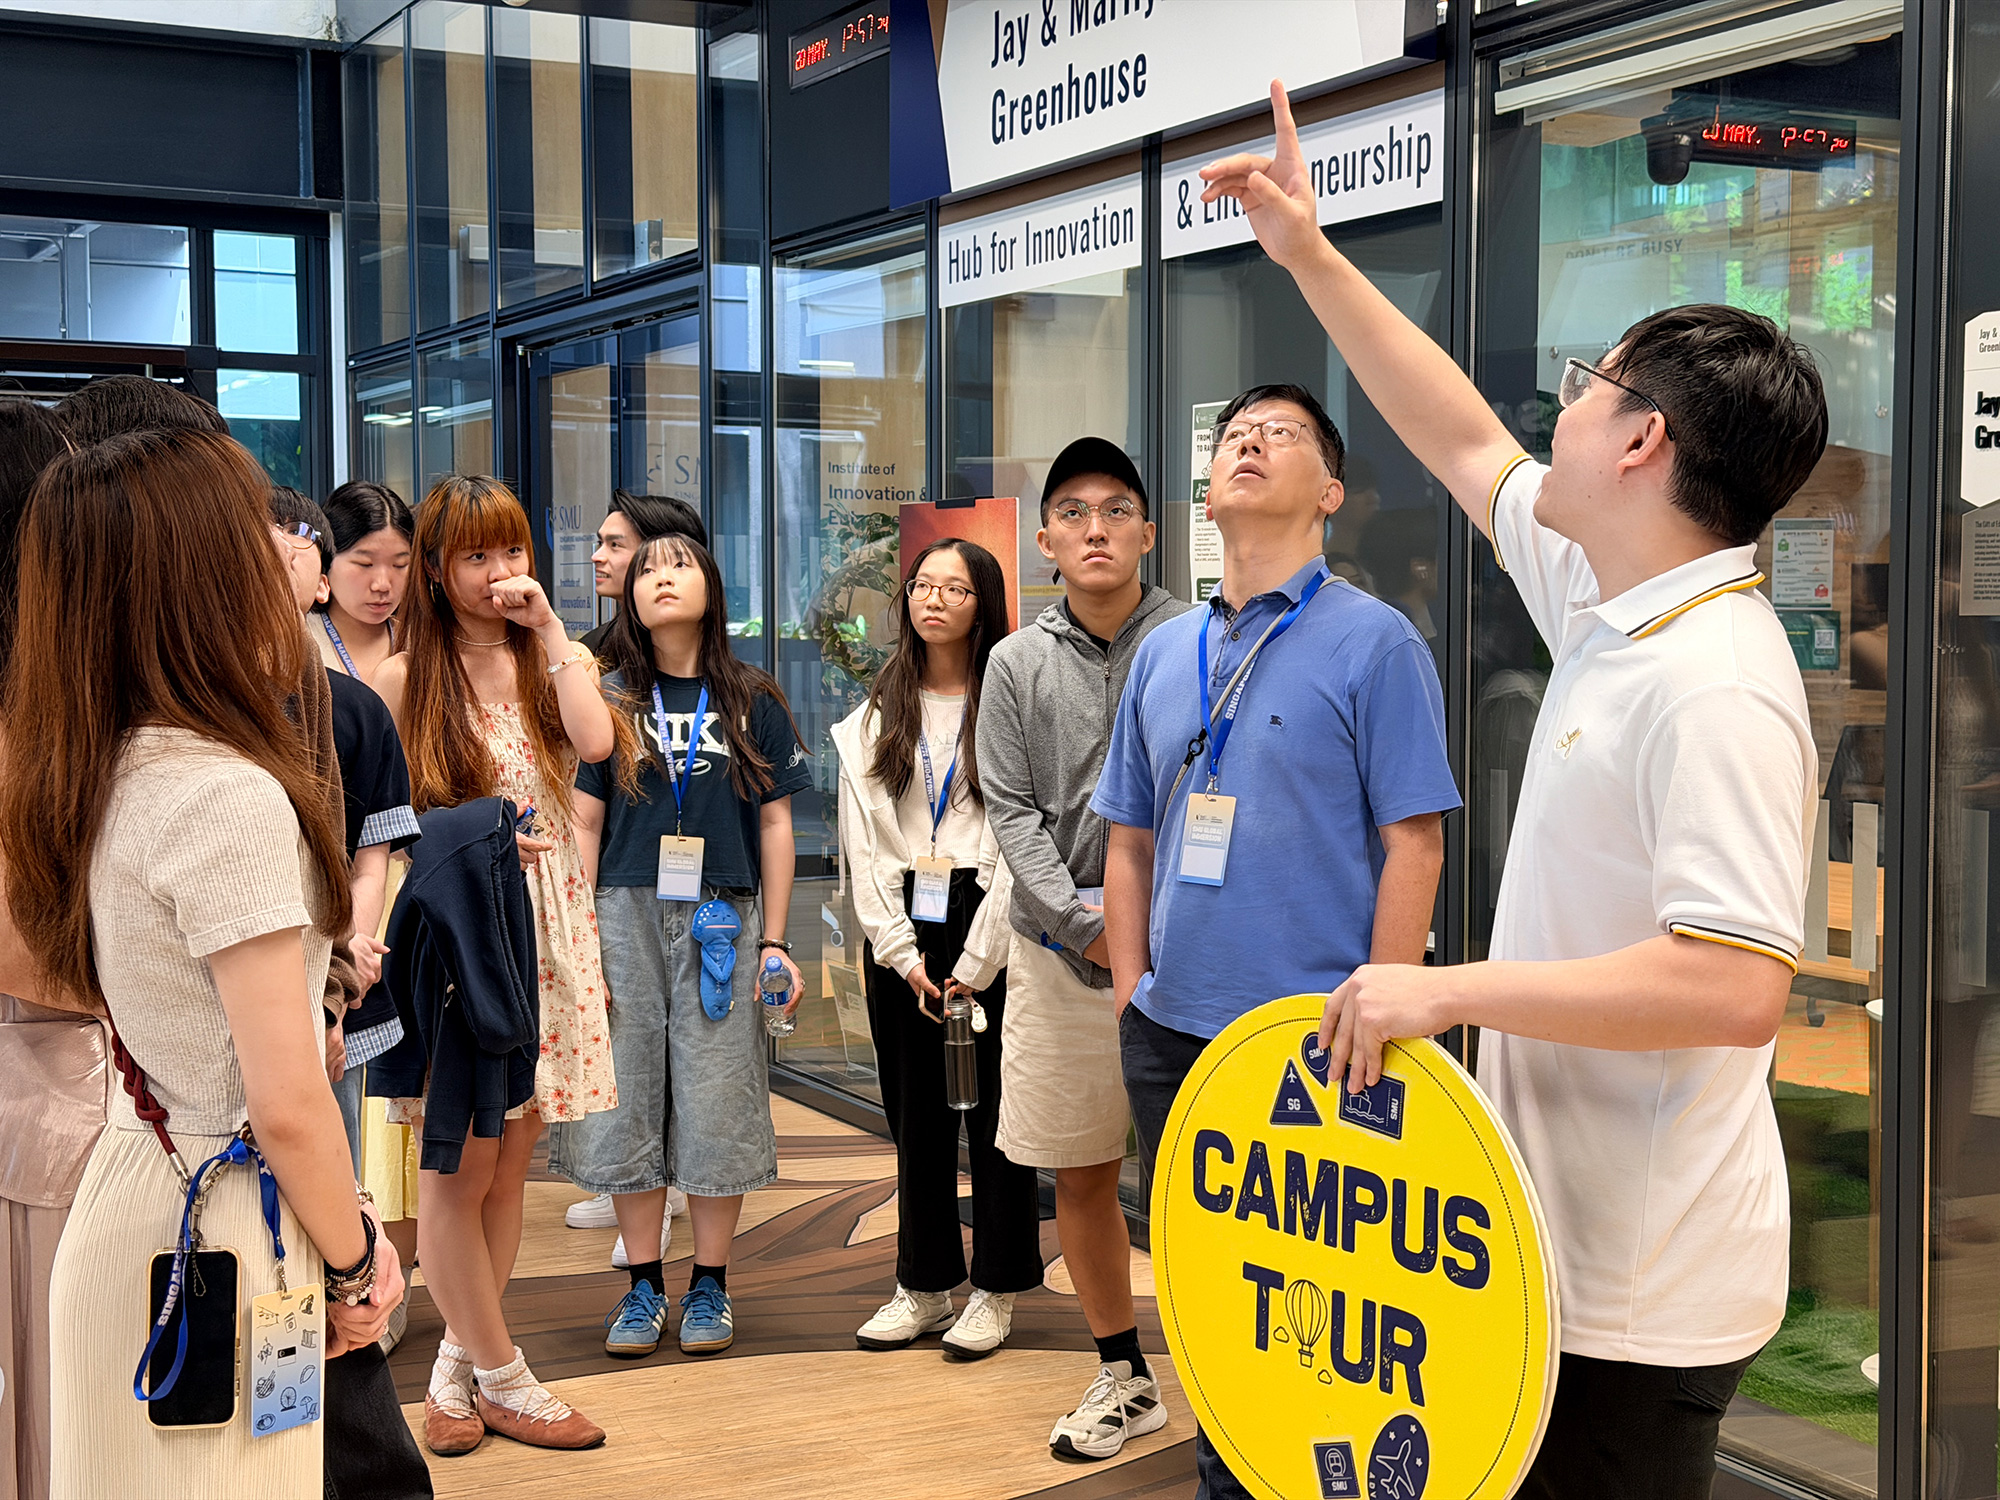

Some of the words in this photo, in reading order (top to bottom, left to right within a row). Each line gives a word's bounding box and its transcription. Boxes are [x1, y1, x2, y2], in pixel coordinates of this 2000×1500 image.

[991, 10, 1030, 68] Jay
[1041, 0, 1056, 47] &
[991, 53, 1147, 145] Greenhouse
[1722, 123, 1762, 144] MAY.
[1177, 179, 1193, 230] &
[948, 234, 982, 285] Hub
[990, 230, 1017, 275] for
[1025, 202, 1134, 267] Innovation
[1642, 238, 1684, 256] BUSY
[828, 461, 881, 475] Institute
[882, 463, 896, 475] of
[829, 484, 915, 501] Innovation
[559, 505, 582, 531] SMU
[633, 712, 748, 763] NIK
[1287, 1098, 1301, 1110] SG
[1390, 1098, 1399, 1121] SMU
[1193, 1129, 1491, 1290] CAMPUS
[1331, 1480, 1348, 1492] SMU
